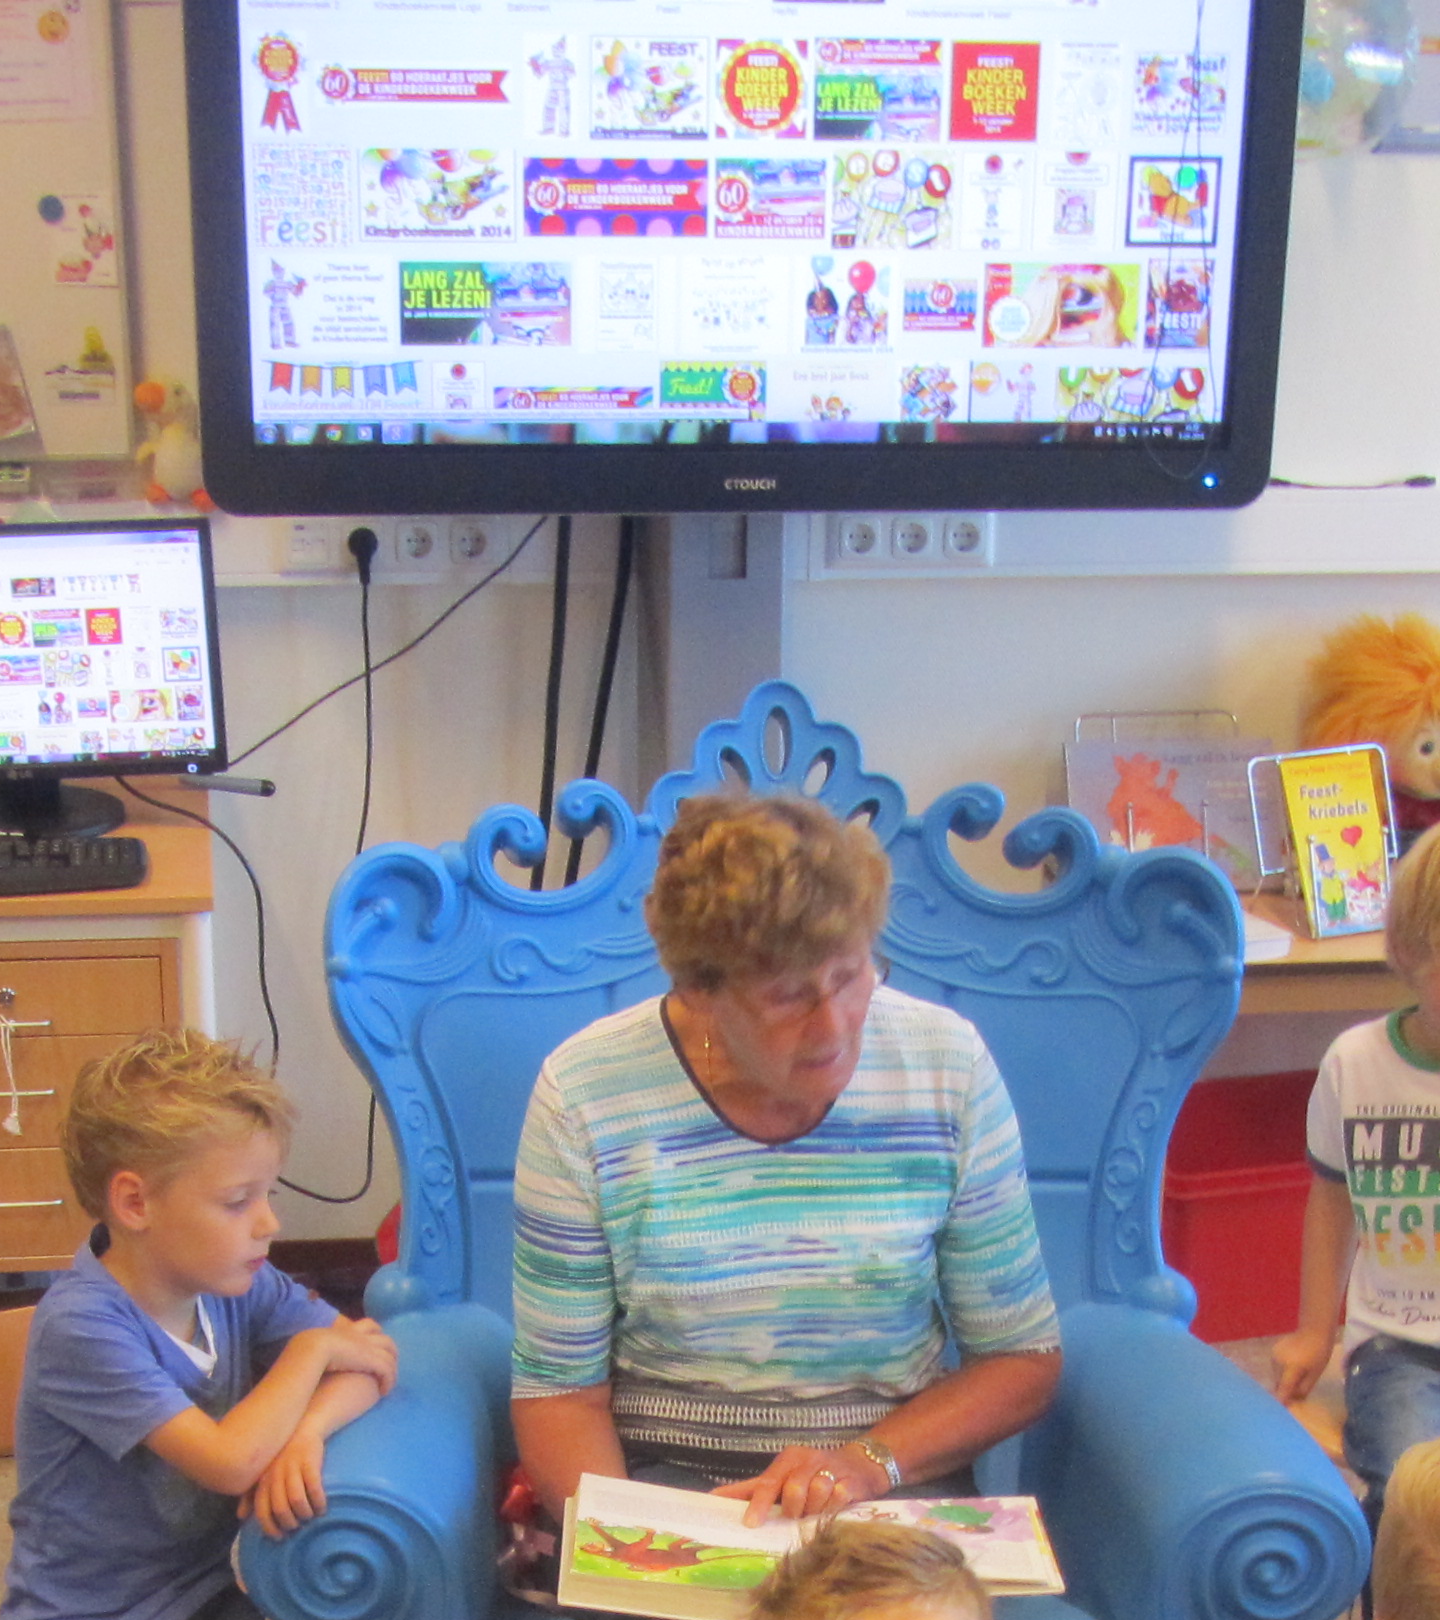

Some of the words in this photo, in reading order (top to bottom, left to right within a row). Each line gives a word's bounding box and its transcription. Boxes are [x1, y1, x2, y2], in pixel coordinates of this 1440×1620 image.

[736, 67, 788, 82] KINDER
[966, 68, 1024, 84] KINDER
[734, 82, 789, 97] BOEKEN
[962, 84, 1027, 100] BOEKEN
[741, 97, 780, 110] WEEK
[972, 100, 1016, 115] WEEK
[719, 182, 745, 206] 60
[365, 225, 475, 238] Kinderboekenweek
[480, 226, 511, 237] 2014
[717, 226, 823, 237] KINDERBOEKENWEEK
[403, 270, 448, 289] LANG
[453, 270, 485, 289] ZAL
[403, 290, 427, 308] JE
[431, 290, 492, 308] LEZEN!
[724, 478, 777, 490] CTOUCH
[1299, 783, 1344, 801] Feest-
[1308, 799, 1369, 820] kriebels
[1356, 1104, 1375, 1116] THE
[1382, 1103, 1438, 1117] ORIGINAL
